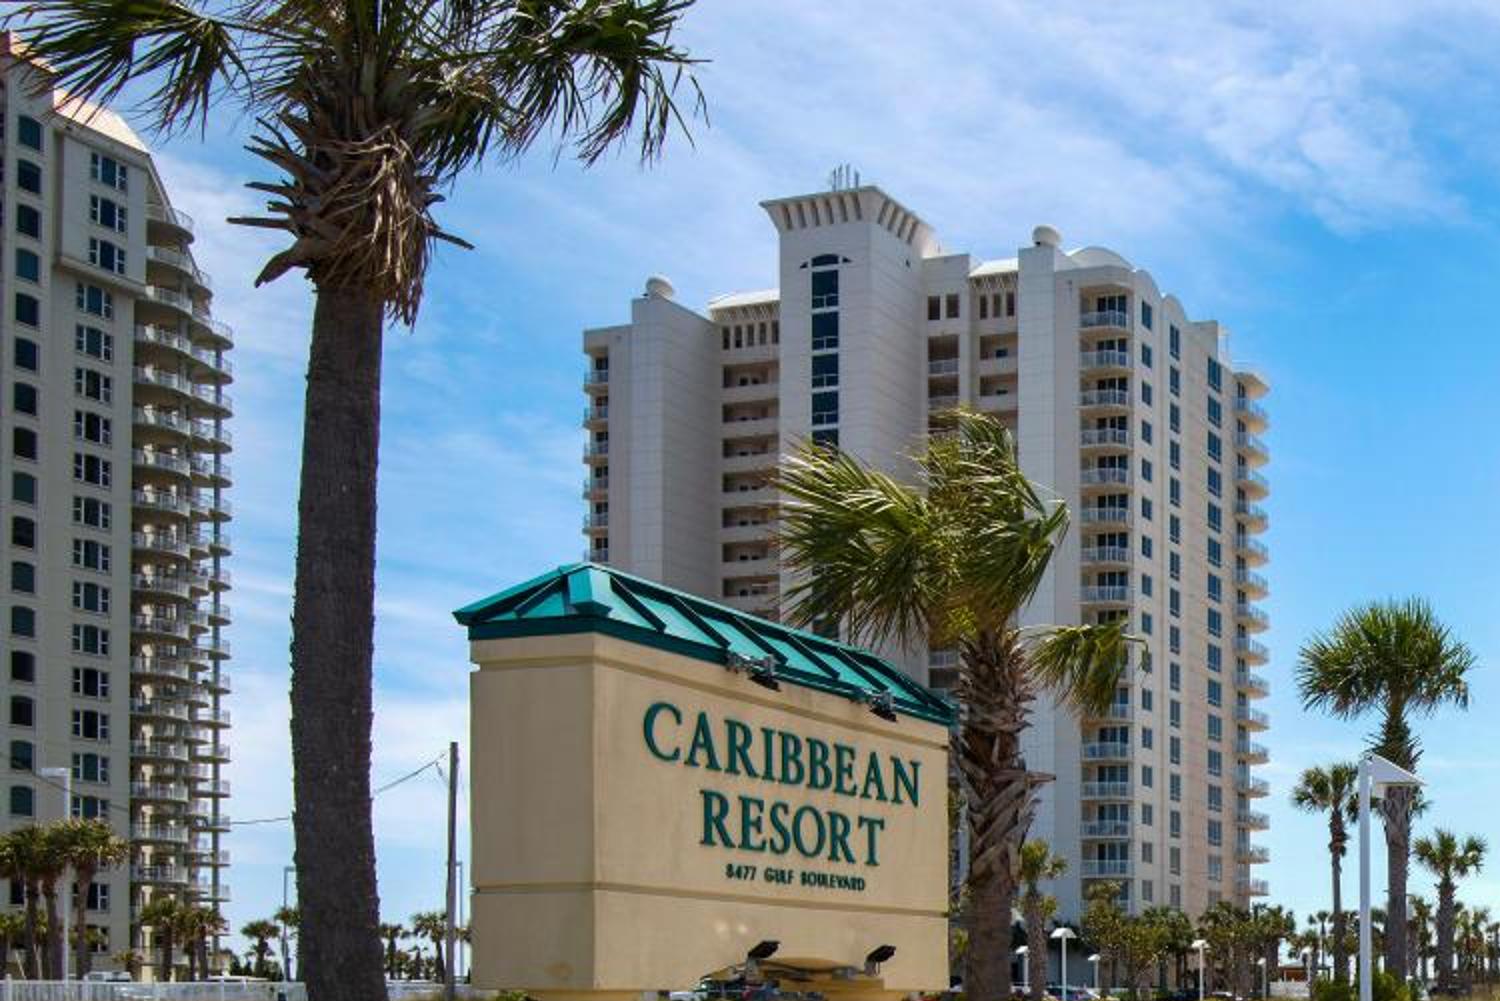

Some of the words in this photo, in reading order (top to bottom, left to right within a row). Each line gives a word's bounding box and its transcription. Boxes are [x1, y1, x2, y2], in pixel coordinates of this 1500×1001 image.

[643, 702, 922, 808] CARIBBEAN
[700, 789, 885, 867] RESORT
[725, 863, 757, 881] 8477
[764, 867, 794, 885] GULF
[800, 871, 866, 892] BOULEVARD
